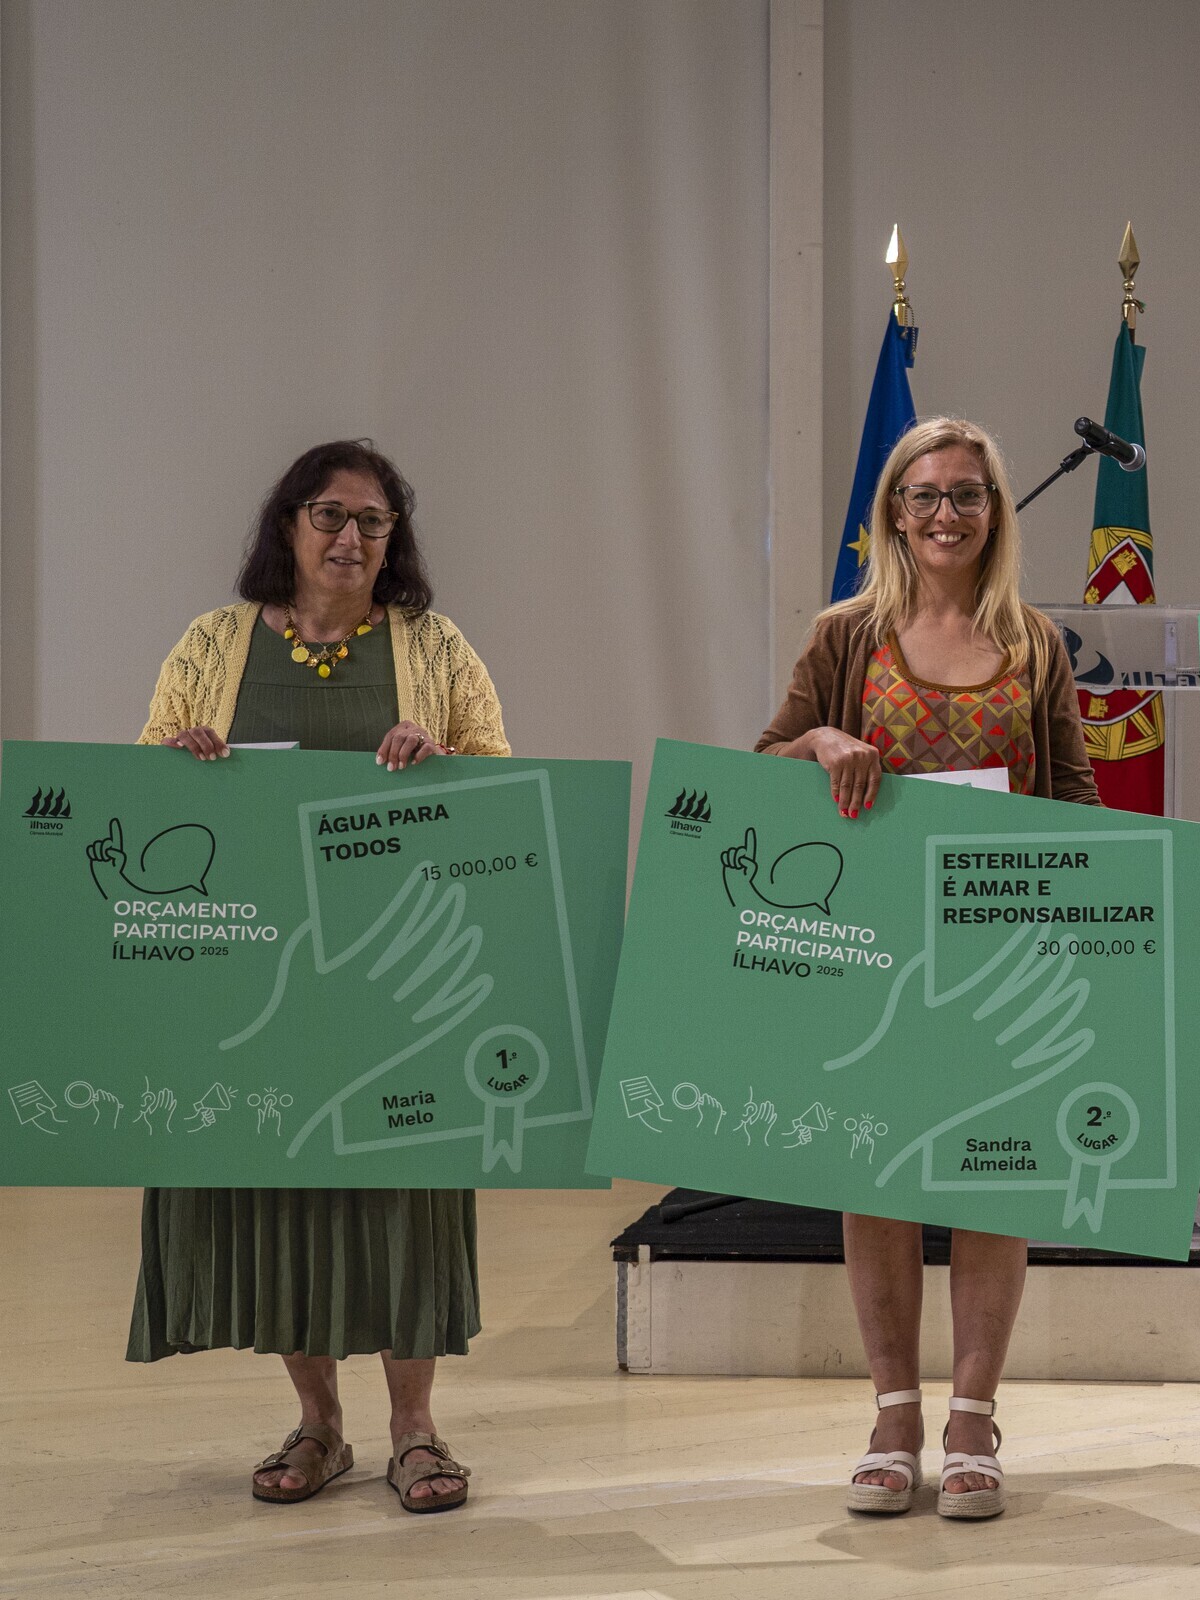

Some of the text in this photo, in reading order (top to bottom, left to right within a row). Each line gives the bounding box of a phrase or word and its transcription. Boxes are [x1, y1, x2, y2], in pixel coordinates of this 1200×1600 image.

[317, 804, 450, 836] ÁGUA PARA
[319, 837, 402, 862] TODOS
[421, 852, 538, 881] 15 000,00 €
[943, 852, 1090, 870] ESTERILIZAR
[943, 875, 1051, 897] É AMAR E
[114, 900, 257, 921] ORÇAMENTO
[943, 905, 1155, 924] RESPONSABILIZAR
[113, 922, 278, 942] PARTICIPATIVO
[738, 908, 877, 945] ORÇAMENTO
[112, 944, 229, 962] ÍLHAVO 2025
[735, 930, 894, 970] PARTICIPATIVO
[1037, 939, 1156, 958] 30 000,00 €
[733, 948, 844, 978] ÍLHAVO 2025
[487, 1073, 530, 1092] LUGAR
[382, 1090, 436, 1111] Maria
[387, 1109, 434, 1129] Melo
[966, 1136, 1032, 1153] Sandra
[1076, 1132, 1119, 1150] LUGAR
[960, 1155, 1038, 1172] Almeida
